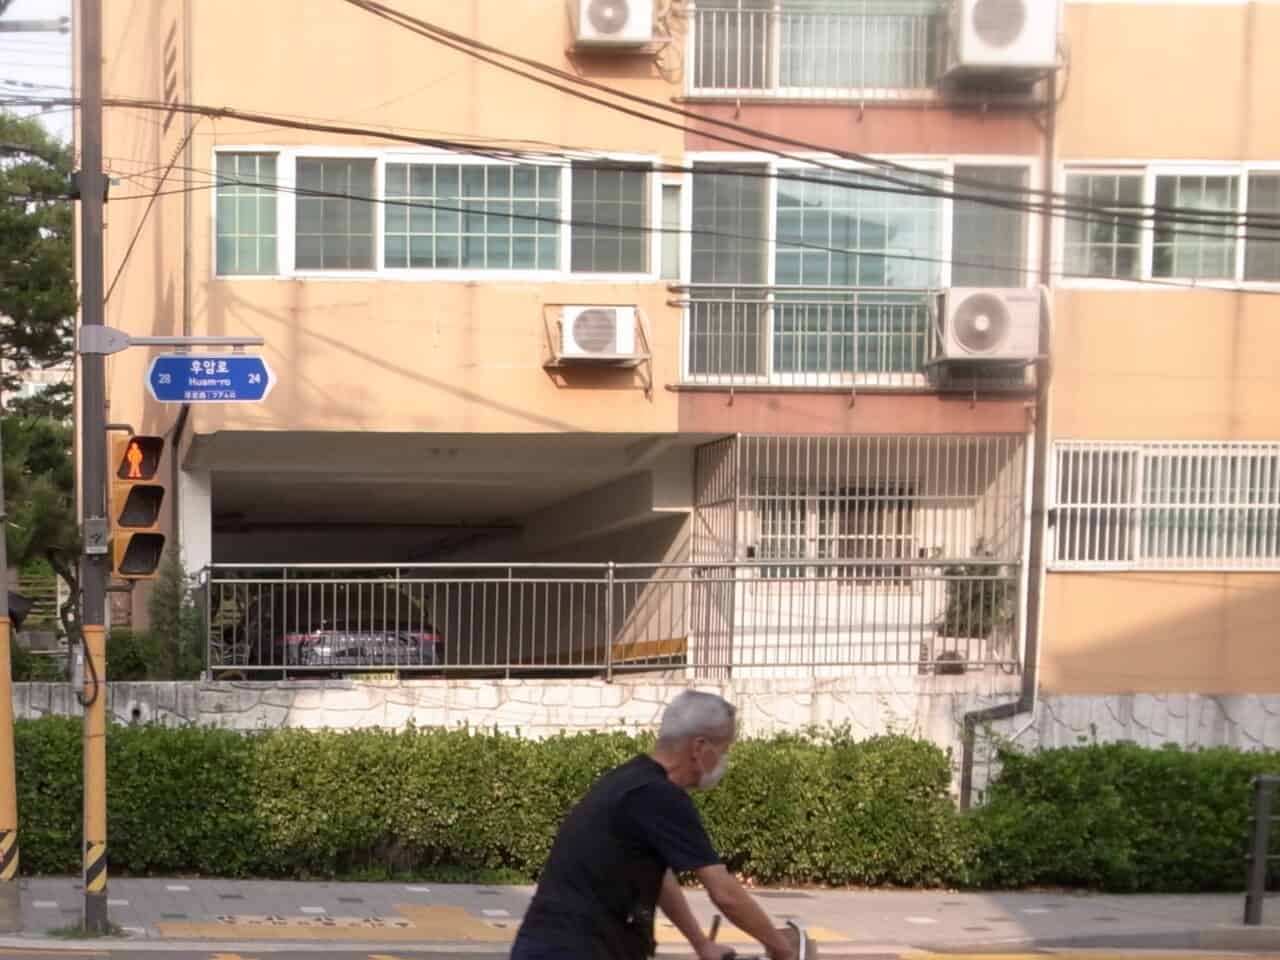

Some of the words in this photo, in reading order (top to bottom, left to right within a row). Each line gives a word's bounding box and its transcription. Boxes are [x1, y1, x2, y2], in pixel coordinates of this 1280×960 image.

[190, 360, 230, 375] 후암로
[158, 373, 172, 385] 28
[188, 377, 231, 386] Huam-ro
[247, 373, 261, 385] 24
